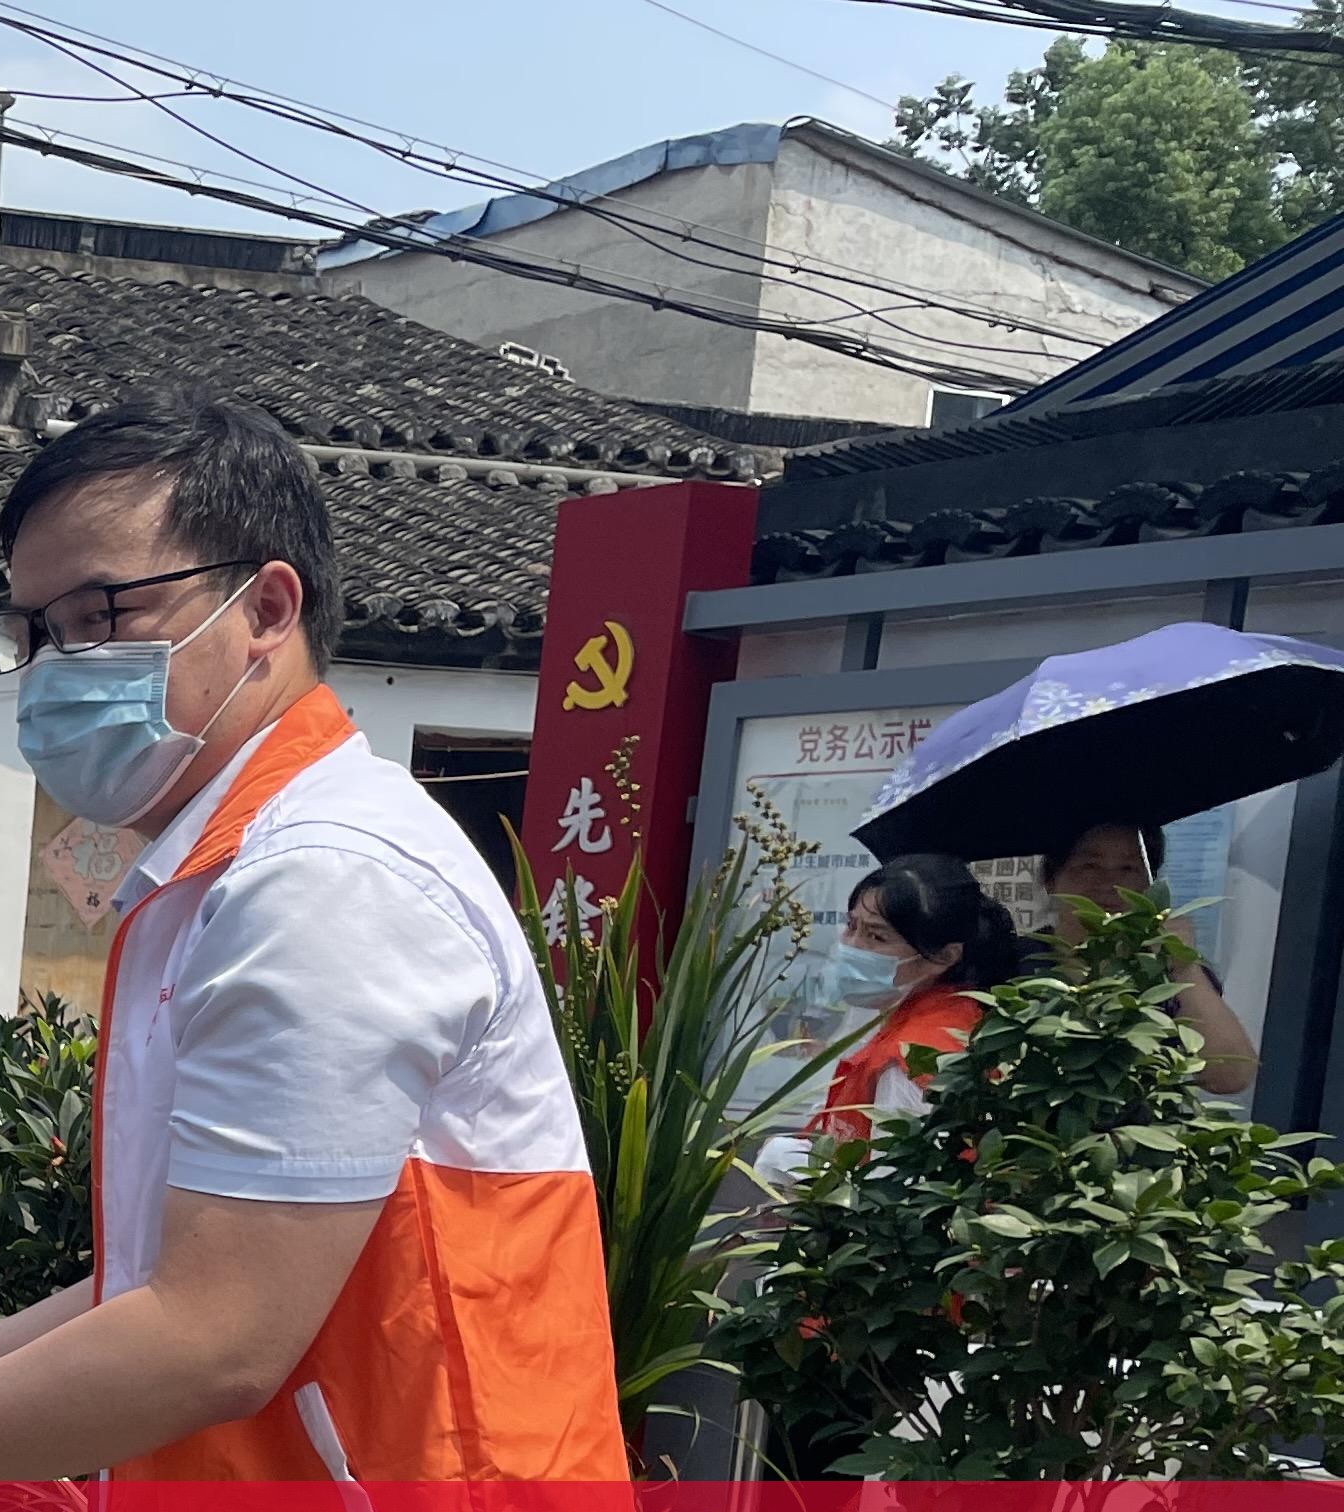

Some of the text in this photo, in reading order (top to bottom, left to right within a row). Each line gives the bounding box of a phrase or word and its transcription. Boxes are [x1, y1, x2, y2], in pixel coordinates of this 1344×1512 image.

[796, 718, 932, 764] 党务公示栏
